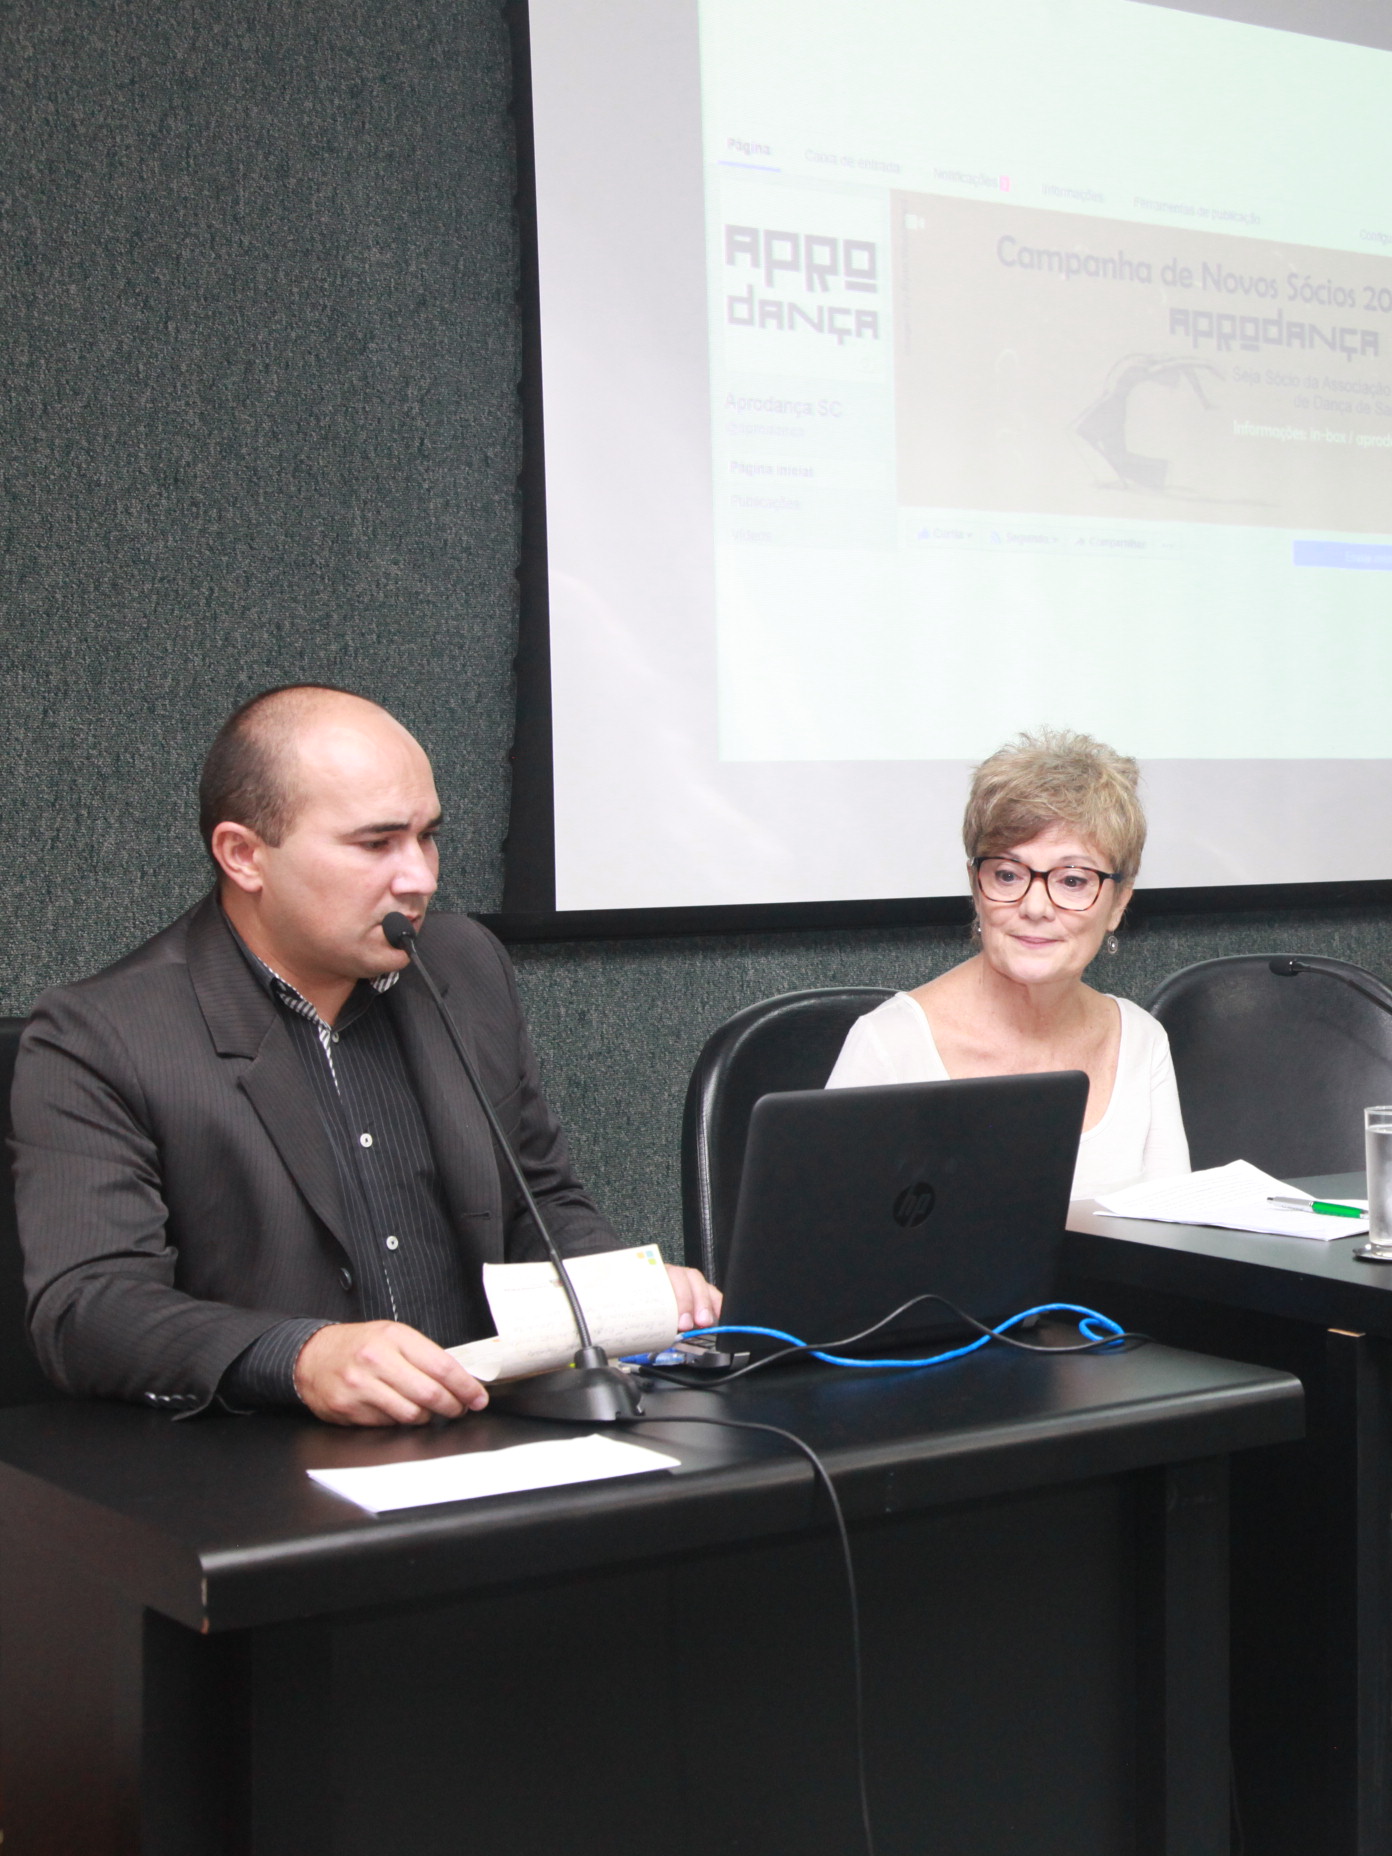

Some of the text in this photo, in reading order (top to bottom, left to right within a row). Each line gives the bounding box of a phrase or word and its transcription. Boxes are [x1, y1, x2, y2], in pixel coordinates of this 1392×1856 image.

[995, 234, 1154, 285] Campanha
[1160, 257, 1194, 289] de
[1201, 260, 1279, 300] Novos
[1286, 271, 1357, 308] Sócios
[1232, 365, 1260, 387] Seja
[1265, 368, 1300, 388] Sócio
[1322, 375, 1391, 398] Associação
[817, 398, 843, 418] SC
